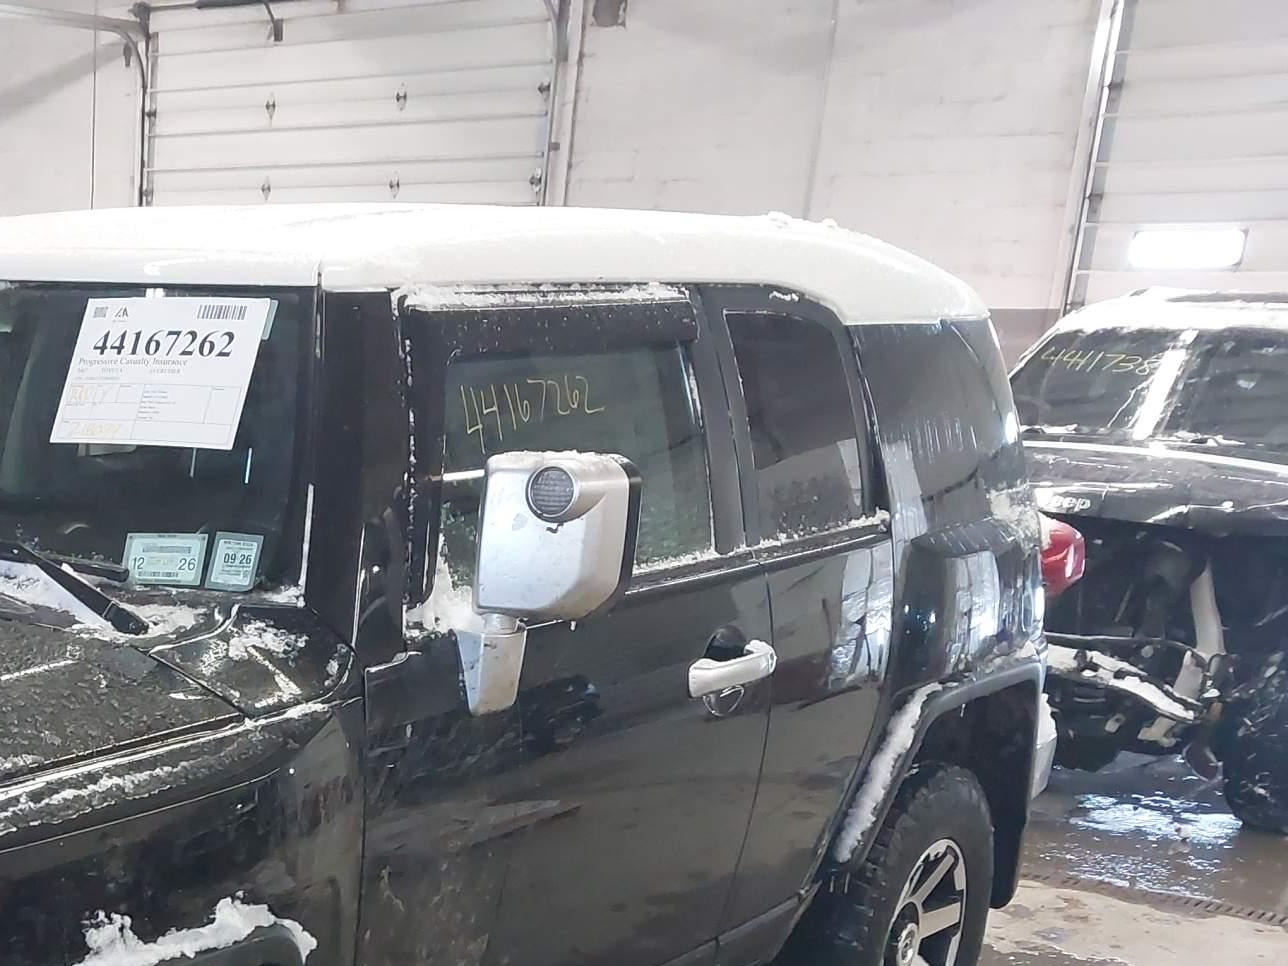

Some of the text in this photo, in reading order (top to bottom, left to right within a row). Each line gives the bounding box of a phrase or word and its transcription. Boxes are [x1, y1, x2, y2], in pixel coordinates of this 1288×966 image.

[93, 329, 235, 358] 44167262
[78, 357, 188, 367] Progressive Casualty Insurance
[460, 375, 605, 455] 44167262
[132, 556, 197, 571] 12 26
[223, 552, 252, 565] 09 26
